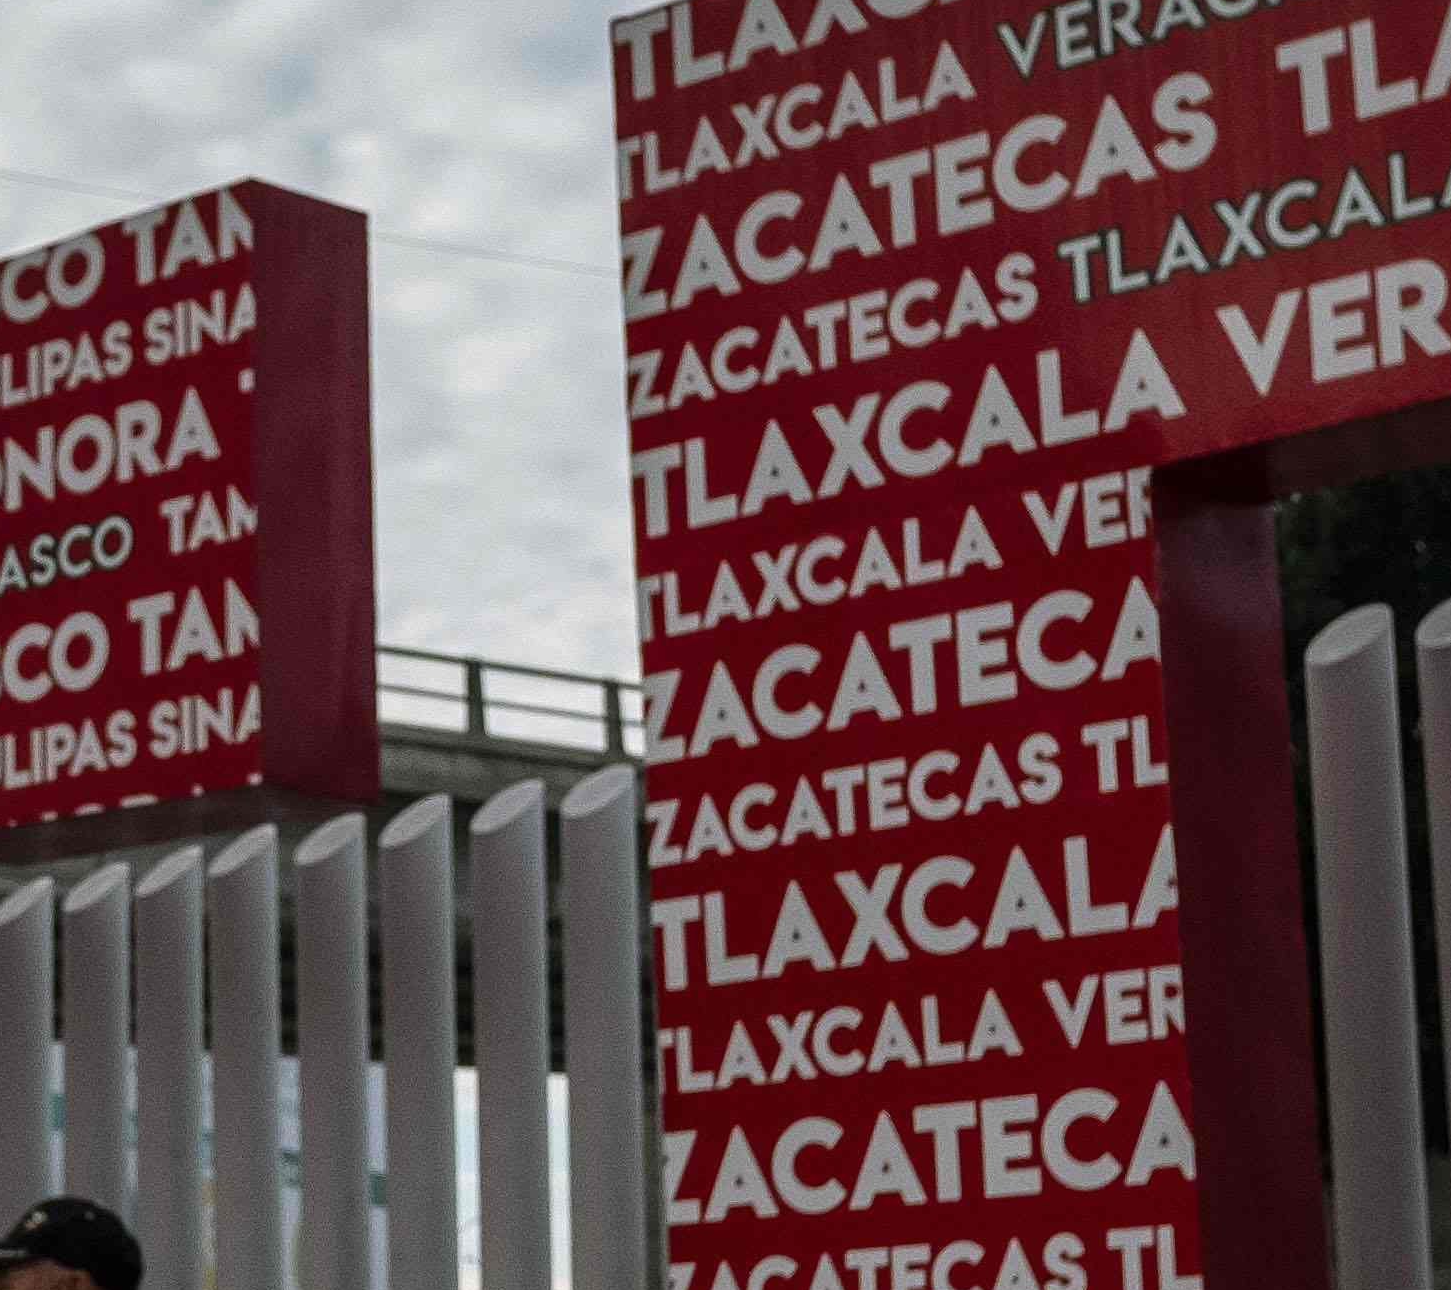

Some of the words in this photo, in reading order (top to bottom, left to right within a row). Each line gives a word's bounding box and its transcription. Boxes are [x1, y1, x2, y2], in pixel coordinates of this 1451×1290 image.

[620, 43, 975, 200] TLAXCALA
[624, 73, 1217, 321] ZACATECAS
[629, 254, 1038, 418] ZACATECAS
[633, 329, 1186, 537] TLAXCALA
[638, 507, 1002, 650] TLAXCALA
[642, 577, 1160, 765] ZACATECA
[649, 734, 1062, 867] ZACATECAS
[654, 824, 1178, 990] TLAXCALA
[666, 1082, 1195, 1225] ZACATECA
